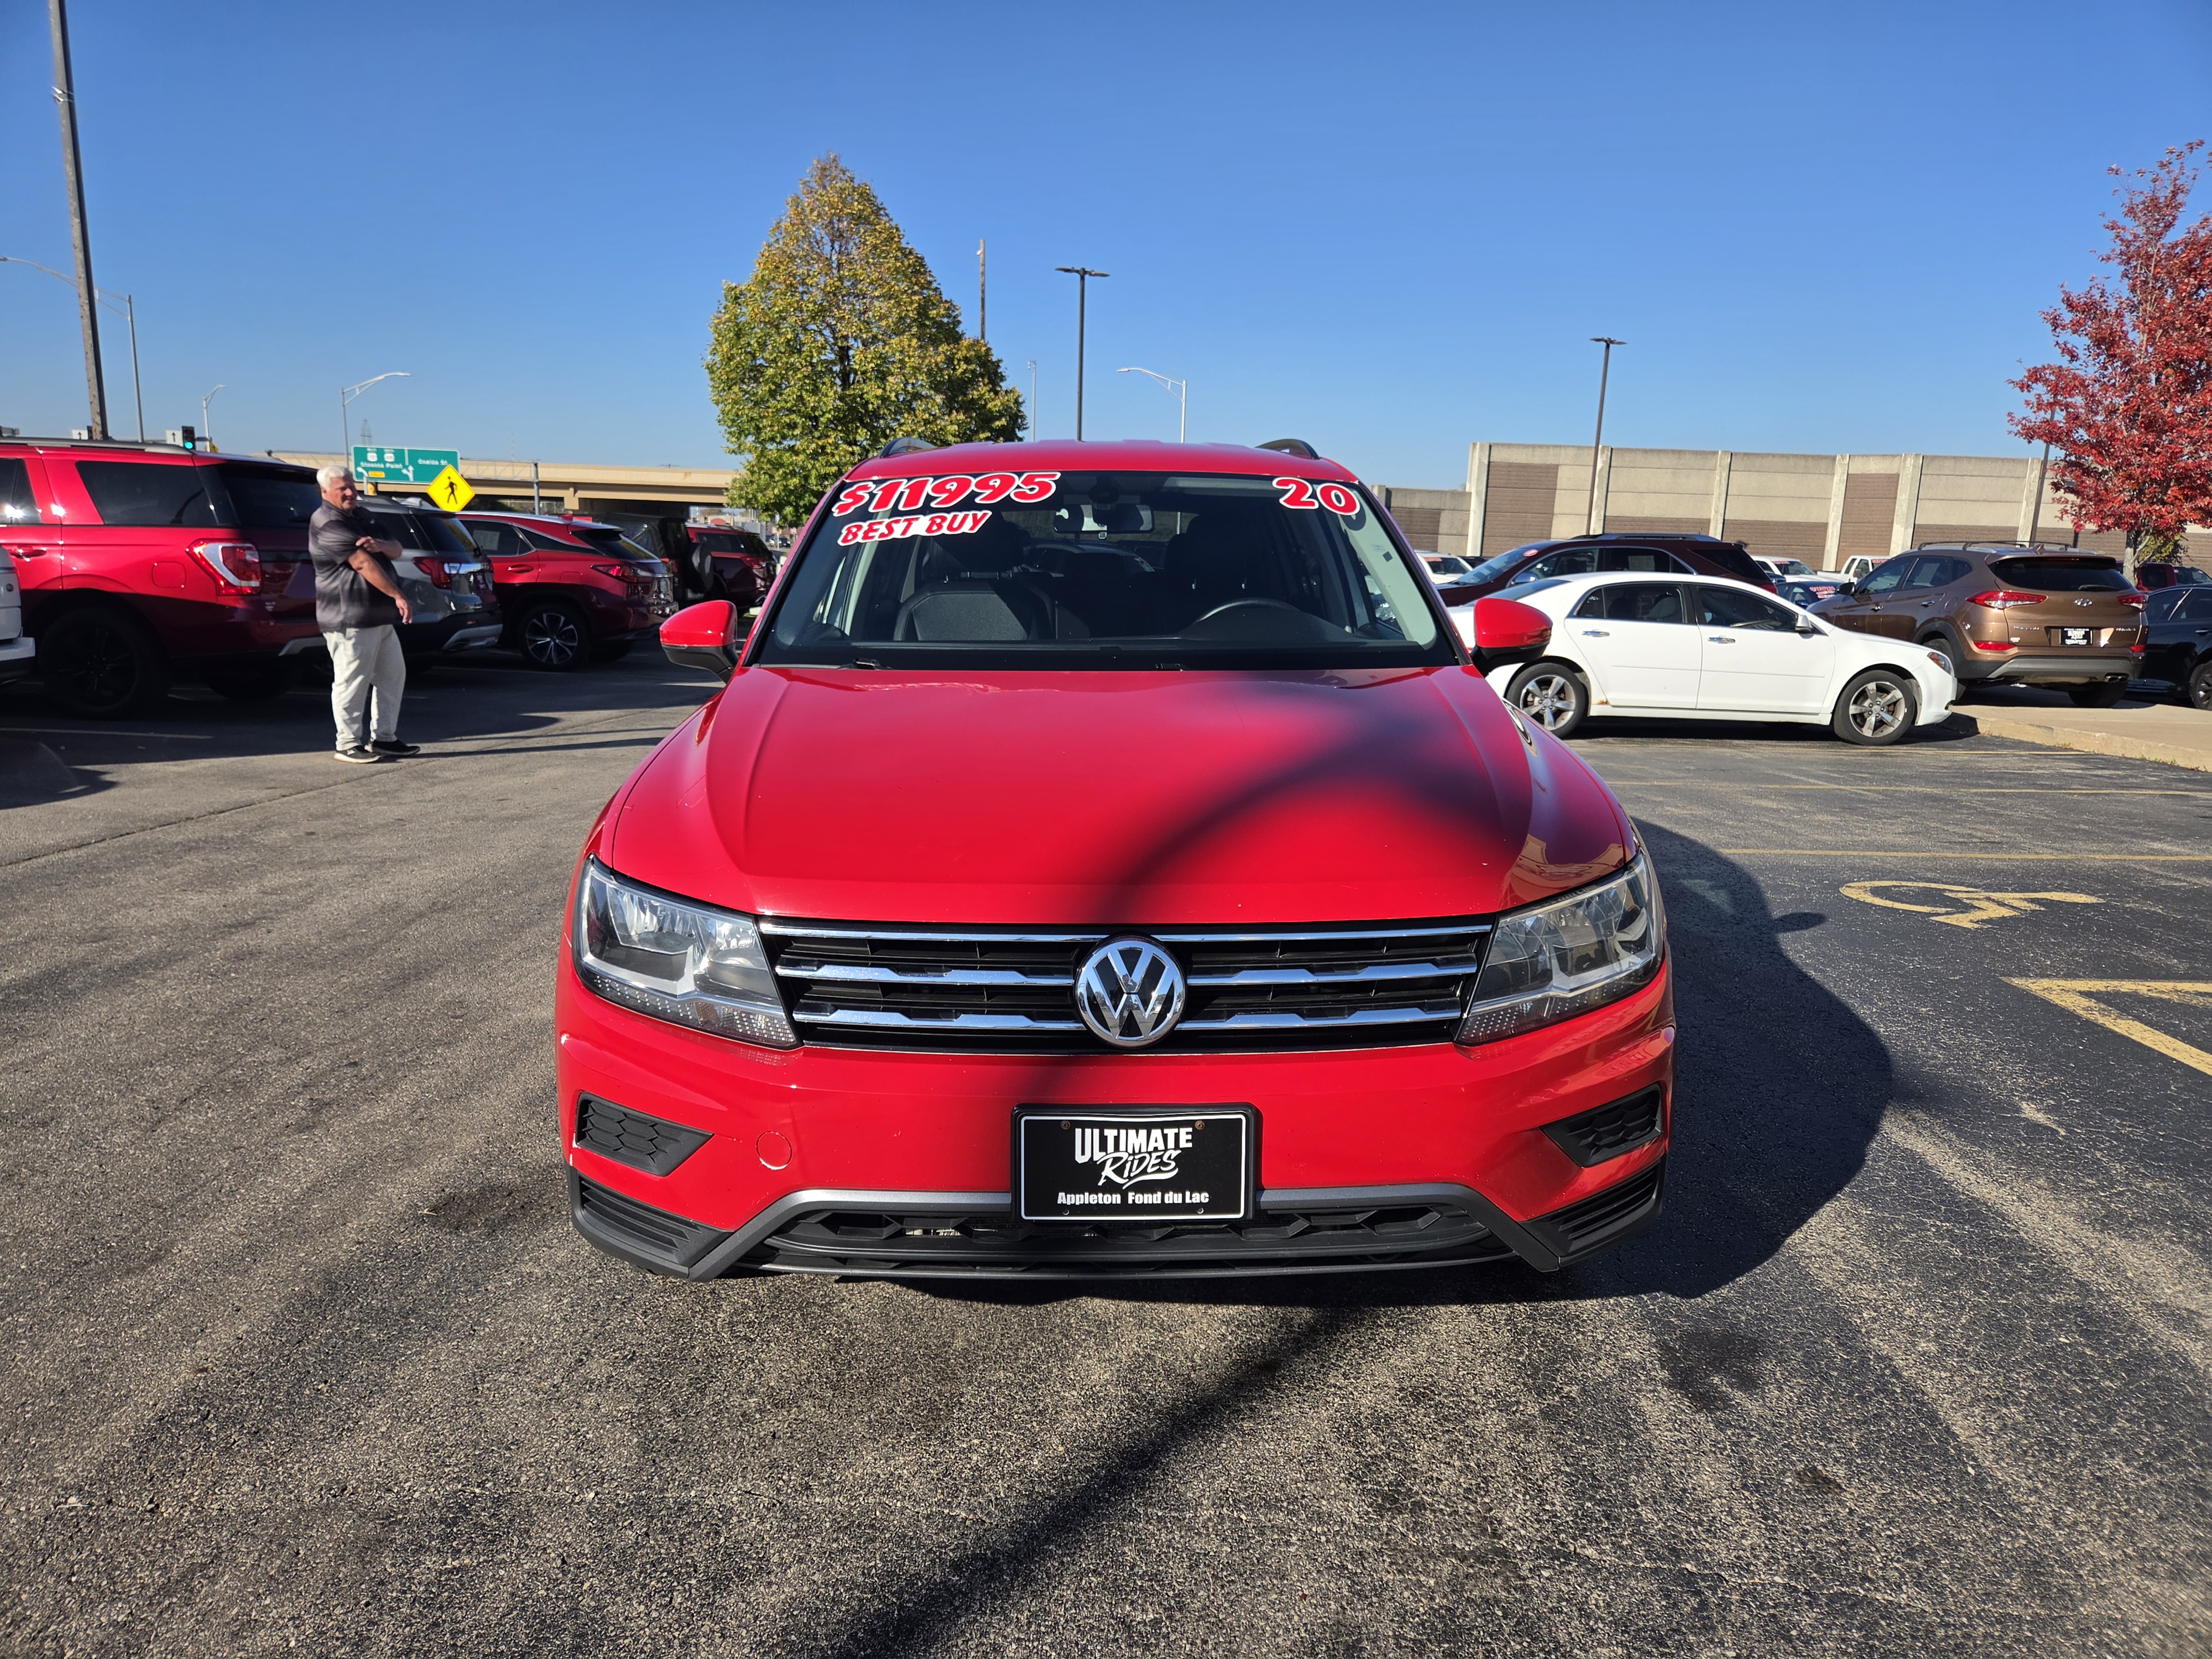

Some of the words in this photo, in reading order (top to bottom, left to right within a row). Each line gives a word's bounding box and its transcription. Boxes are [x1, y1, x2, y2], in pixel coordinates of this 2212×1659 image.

[832, 472, 1061, 517] $11995
[1272, 477, 1360, 515] 20
[838, 515, 920, 546] BEST
[925, 510, 992, 536] BUY
[1074, 1127, 1193, 1164] ULTIMATE
[1057, 1192, 1121, 1206] Appleton
[1128, 1191, 1161, 1204] Fond
[1164, 1191, 1182, 1204] du
[1185, 1191, 1209, 1204] Lac
